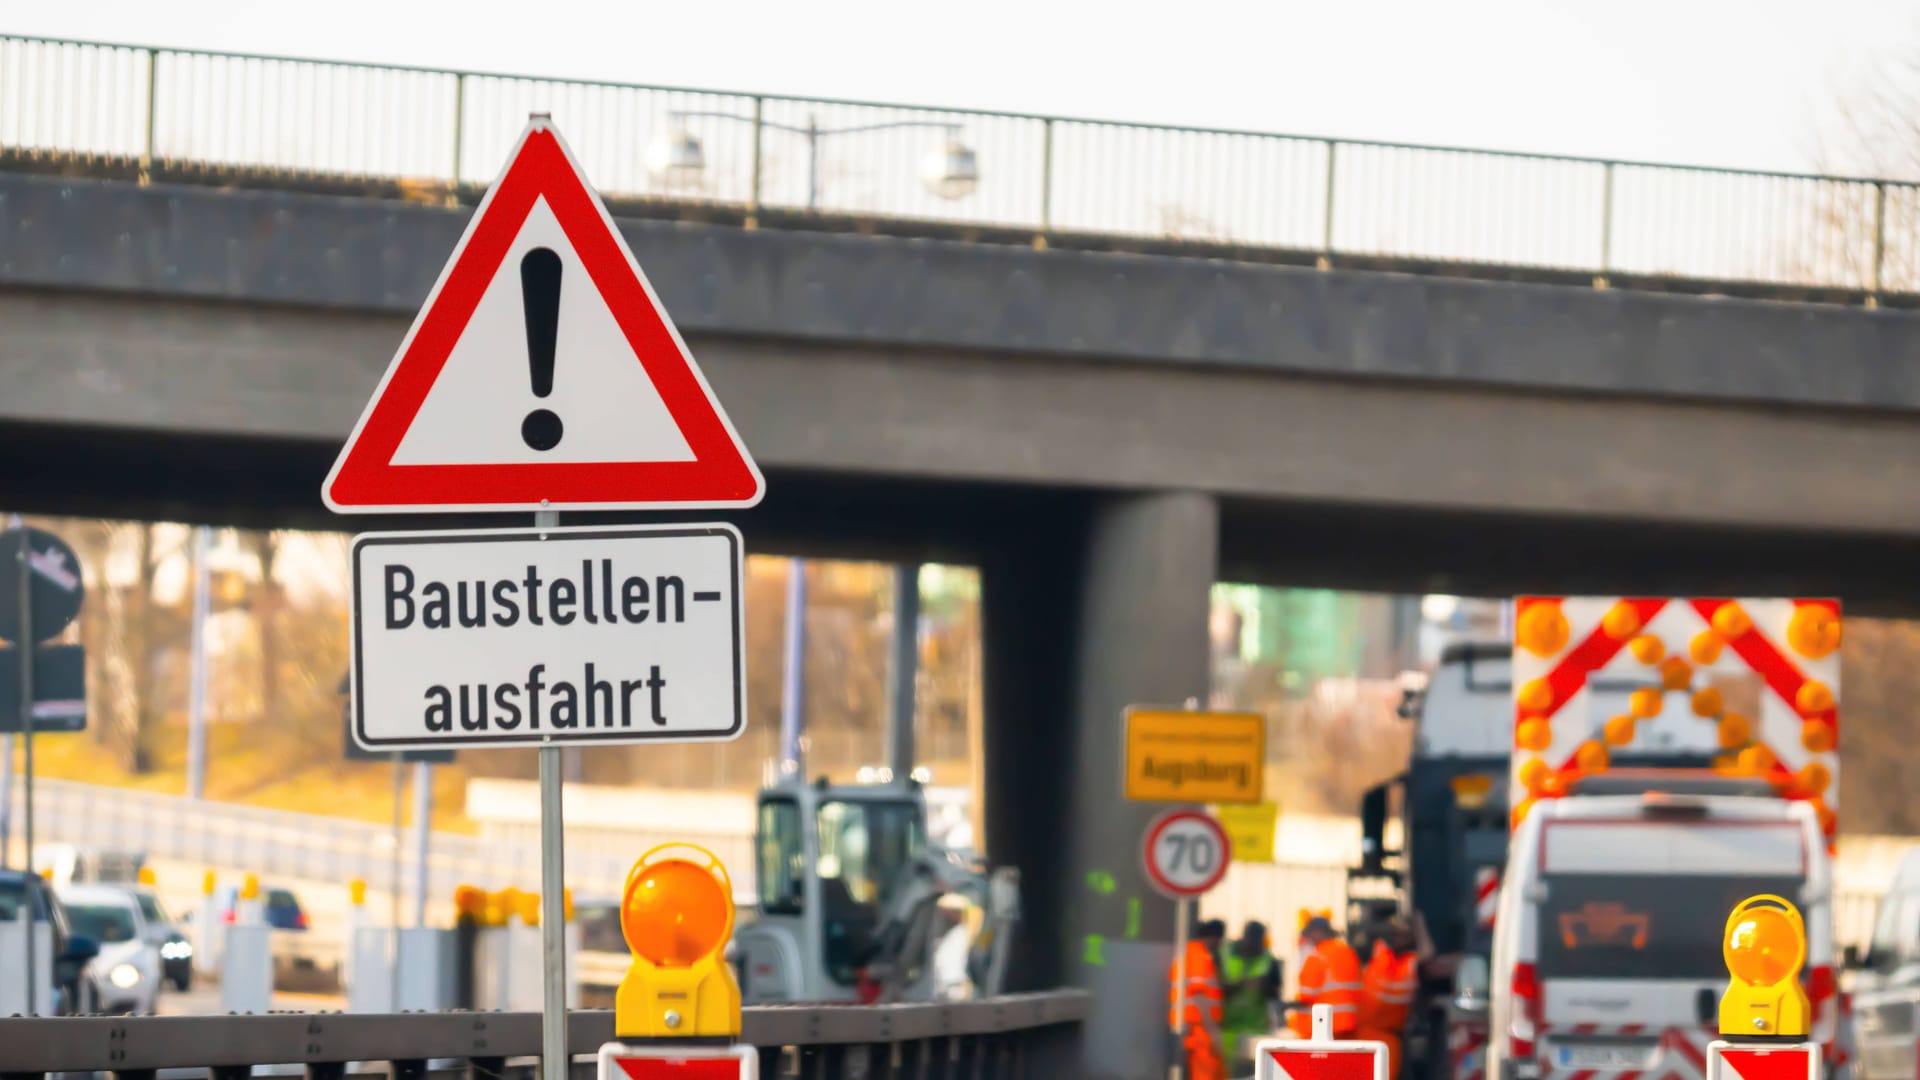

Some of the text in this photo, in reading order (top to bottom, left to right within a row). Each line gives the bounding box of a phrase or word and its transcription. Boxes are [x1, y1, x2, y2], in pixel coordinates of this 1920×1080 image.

[384, 558, 721, 630] Baustellen-
[424, 662, 667, 731] ausfahrt
[1166, 834, 1214, 874] 70
